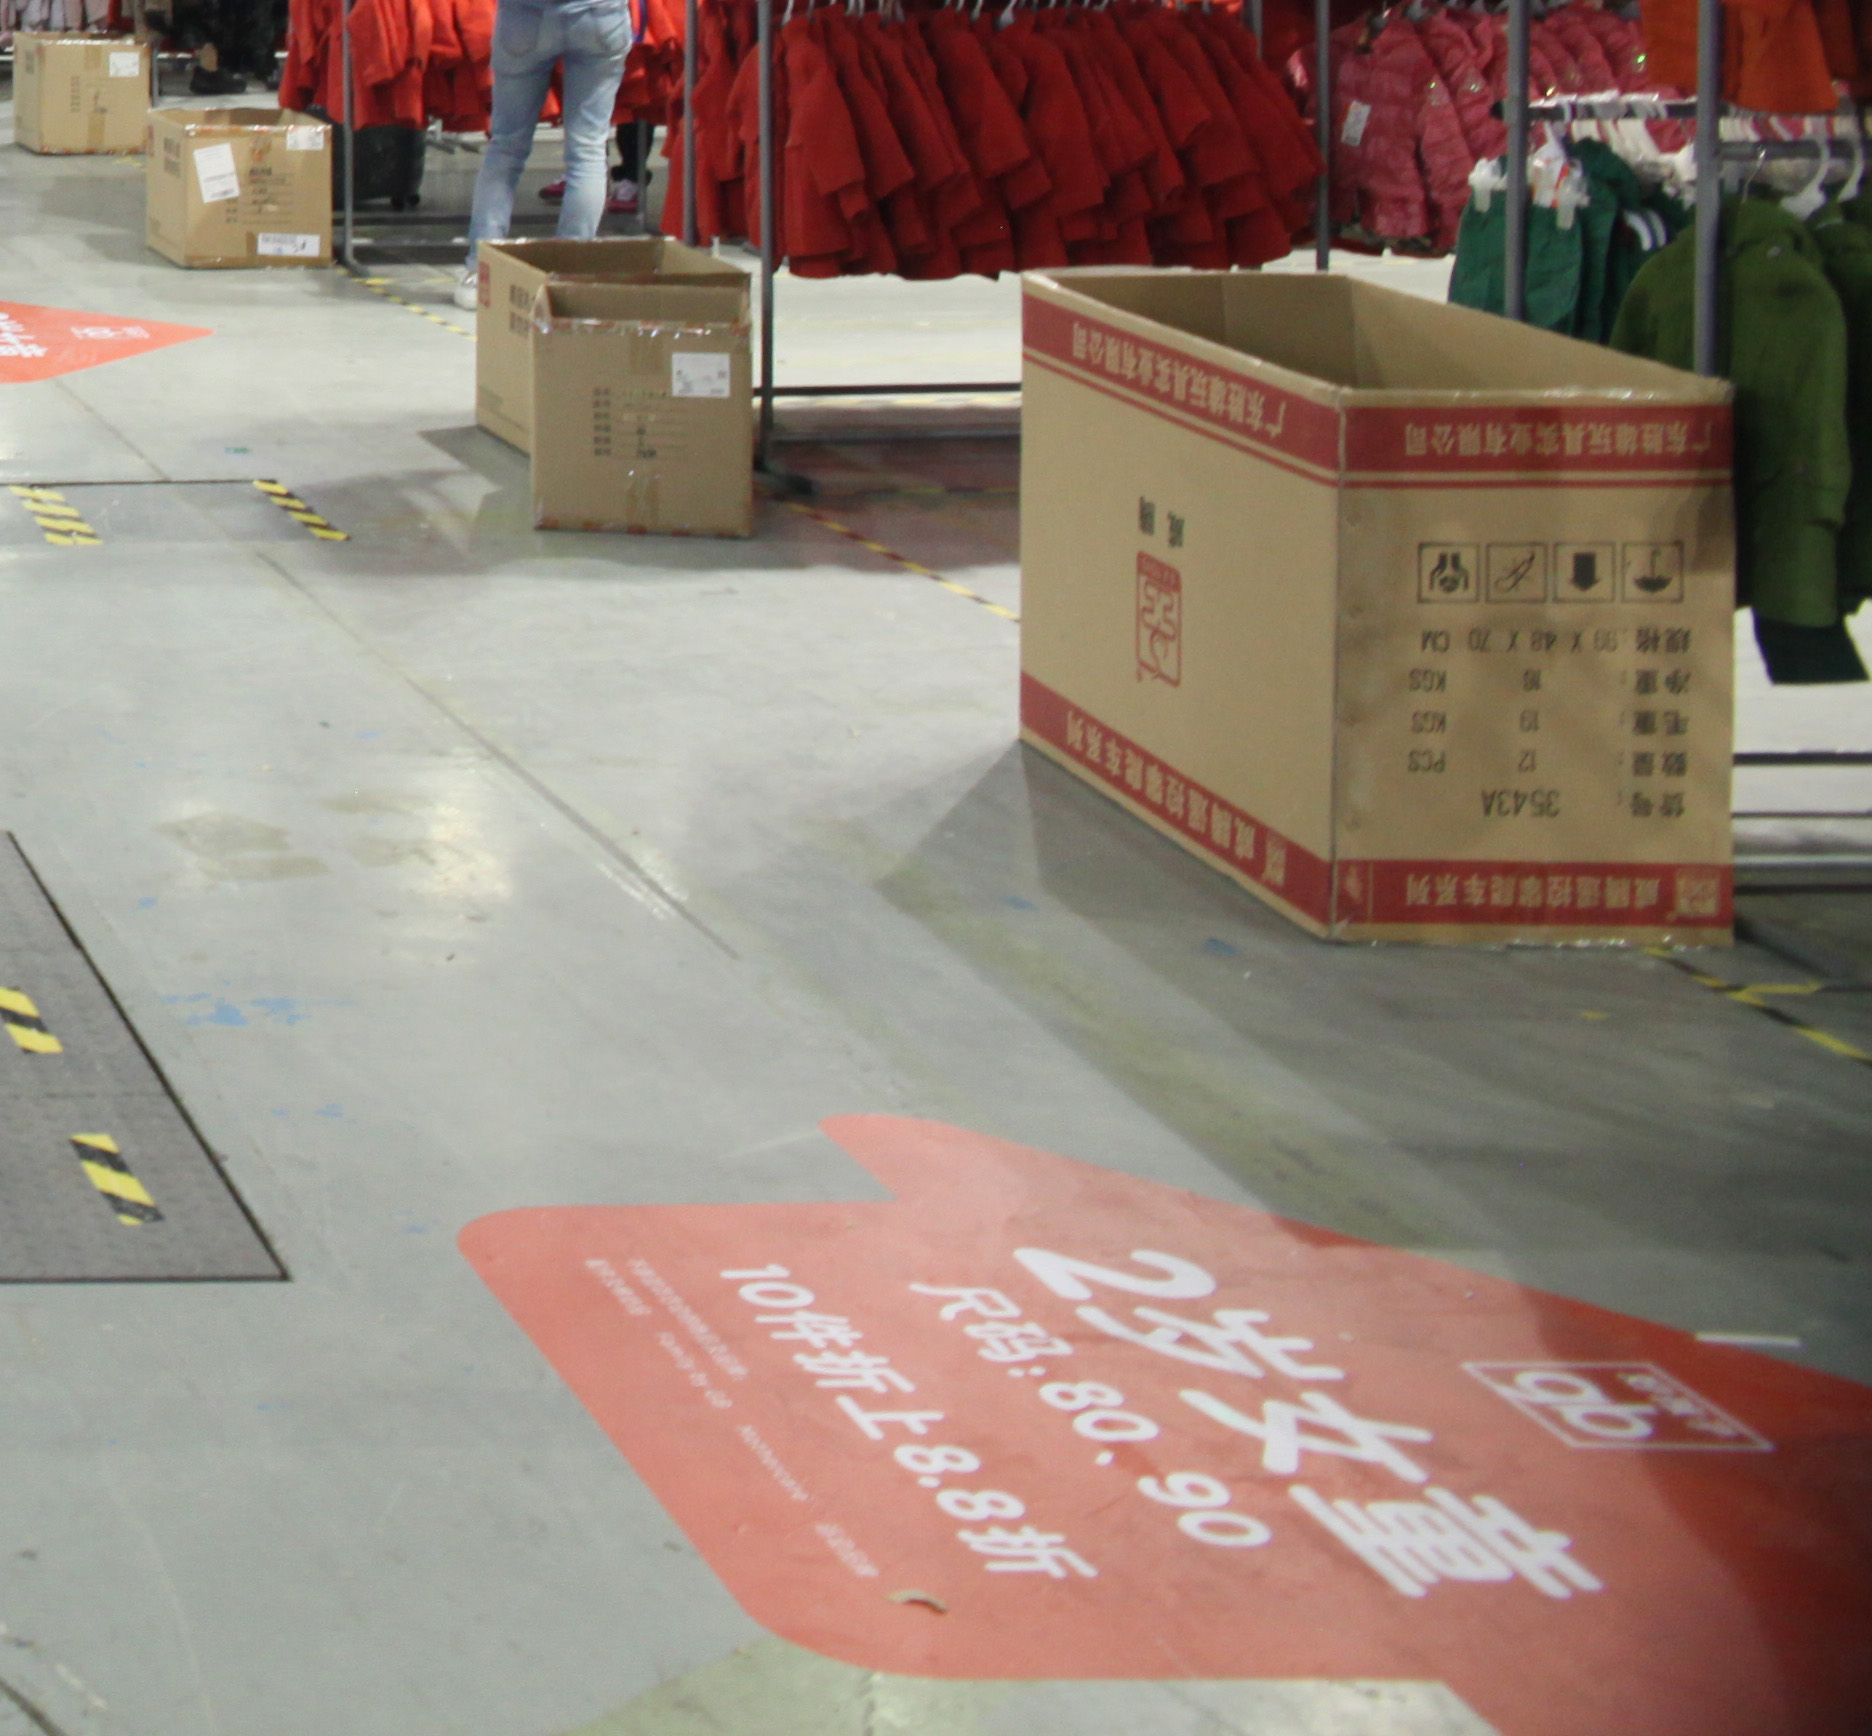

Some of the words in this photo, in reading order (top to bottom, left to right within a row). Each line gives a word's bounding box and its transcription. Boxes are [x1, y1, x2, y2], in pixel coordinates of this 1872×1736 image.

[1421, 629, 1451, 652] CM
[1409, 668, 1447, 693] KGS
[1411, 709, 1447, 735] KGS
[1407, 749, 1447, 775] PCS
[1482, 788, 1562, 817] 3543A
[1512, 1369, 1656, 1440] gb
[720, 1264, 1100, 1579] 10件折上8.8折
[1012, 1247, 1605, 1599] 2岁女童
